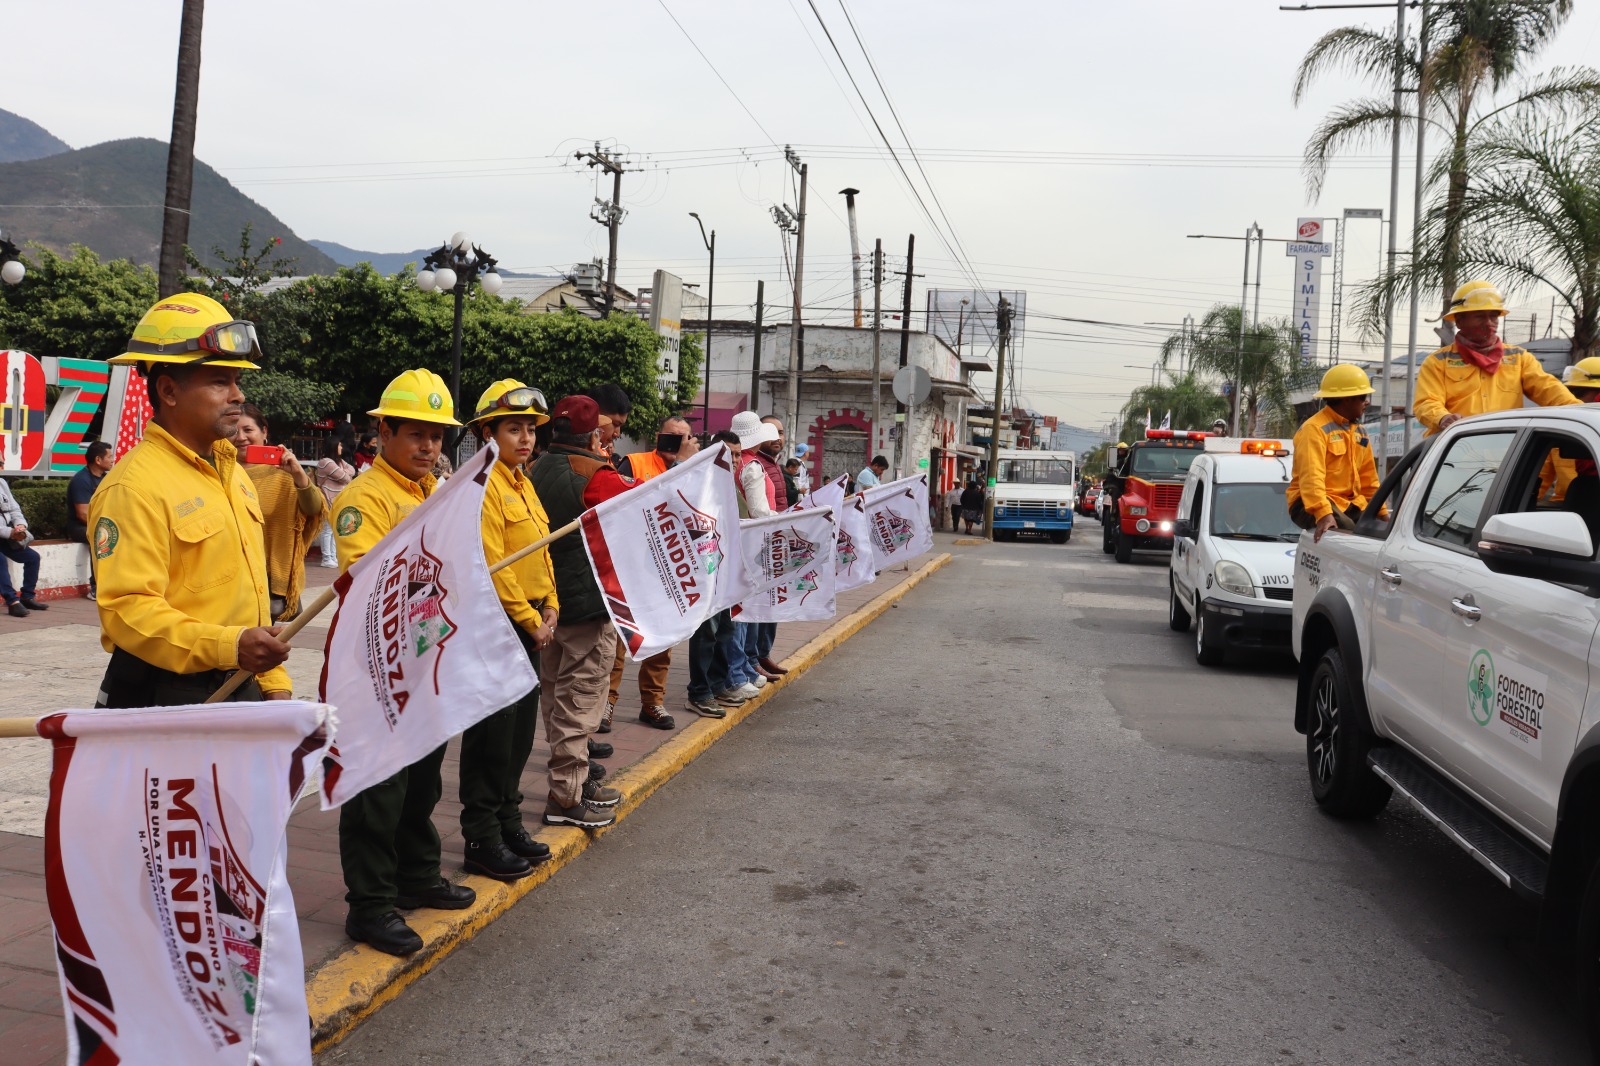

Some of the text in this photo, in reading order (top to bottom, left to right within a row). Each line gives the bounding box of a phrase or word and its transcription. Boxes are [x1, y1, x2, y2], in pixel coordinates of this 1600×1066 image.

[1289, 244, 1329, 254] FARMACIAS
[1300, 260, 1314, 367] SIMILARES
[664, 358, 673, 373] EL
[681, 530, 697, 565] CAMERINO
[875, 511, 896, 554] MENDOZA
[381, 559, 390, 577] POR
[654, 501, 701, 607] MENDOZA
[771, 530, 786, 578] MENDOZA
[1300, 551, 1320, 573] DIESEL
[376, 577, 384, 597] UNA
[382, 545, 410, 714] MENDOZA
[1496, 693, 1542, 730] FORESTAL
[150, 778, 159, 810] POR
[138, 831, 146, 842] H.
[151, 816, 160, 848] UNA
[167, 778, 242, 1046] MENDOZA
[202, 873, 226, 991] CAMERINO Z.
